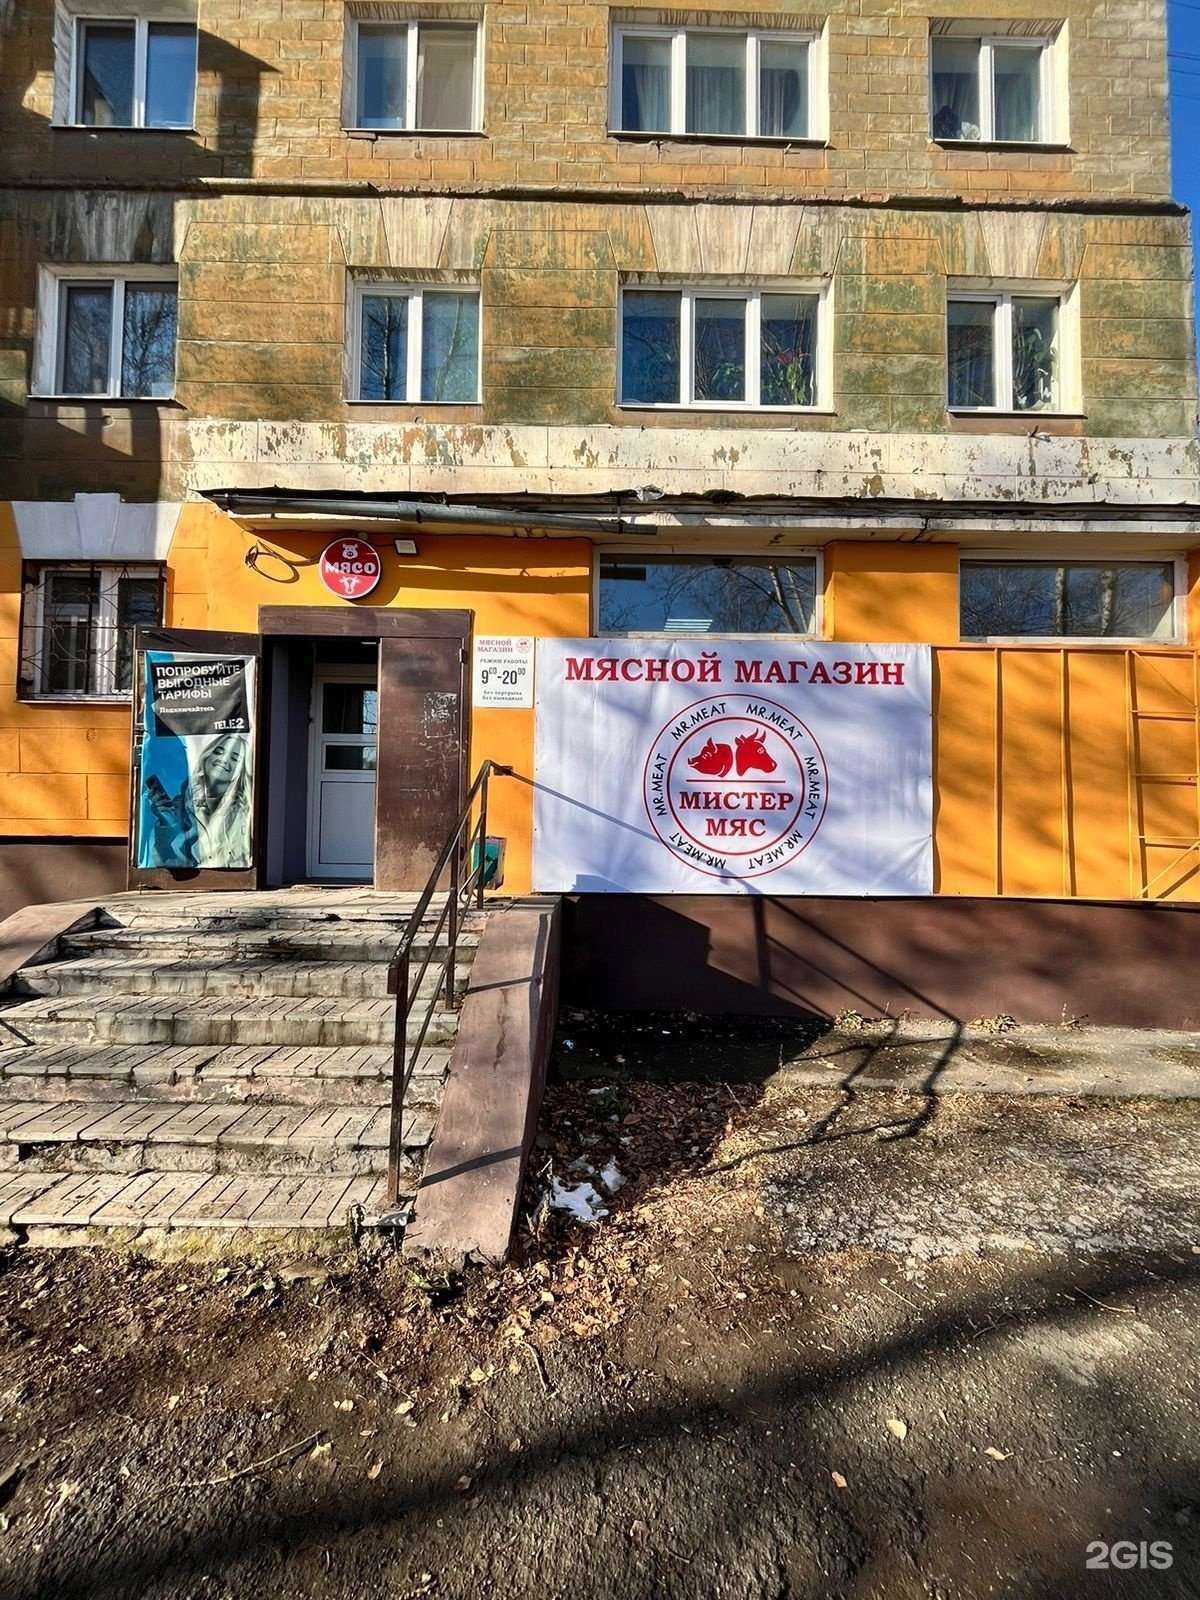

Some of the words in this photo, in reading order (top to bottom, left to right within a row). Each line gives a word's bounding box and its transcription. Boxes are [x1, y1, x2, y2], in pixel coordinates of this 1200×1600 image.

[325, 562, 376, 574] МЯСО
[479, 638, 512, 646] МЯСНОЙ
[156, 663, 241, 677] ПОПРОБУЙТЕ
[565, 652, 722, 683] МЯСНОЙ
[735, 659, 905, 685] МАГАЗИН
[157, 677, 231, 689] ВЫГОДНЫЕ
[159, 690, 212, 700] ТАРИФЫ
[214, 718, 245, 730] TELE2
[671, 702, 726, 740] MR.MEAT
[746, 703, 803, 741] MR.MEAT
[654, 753, 667, 816] MR.MEAT
[804, 756, 817, 820] MR.MEAT
[679, 791, 794, 810] МИСТЕР
[705, 818, 767, 837] МЯС
[669, 832, 726, 869] MR.MEAT
[748, 829, 803, 870] MR.MEAT
